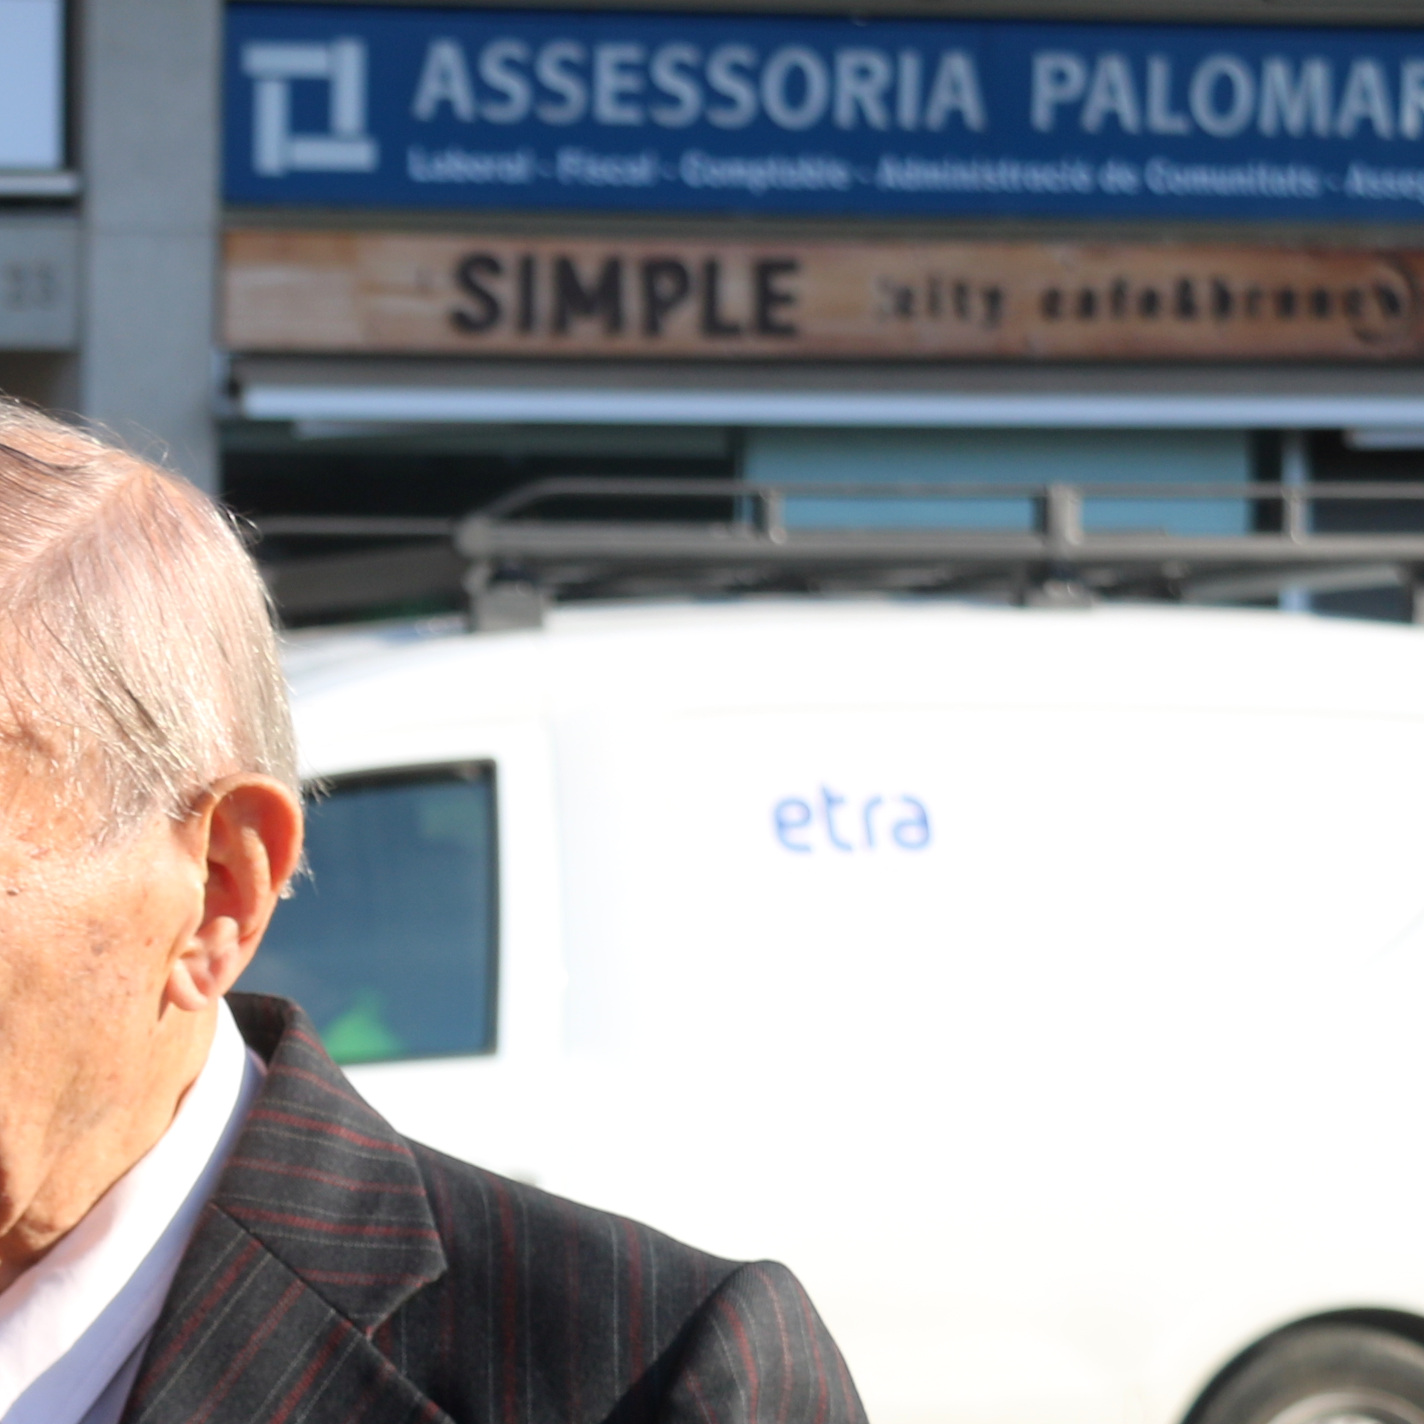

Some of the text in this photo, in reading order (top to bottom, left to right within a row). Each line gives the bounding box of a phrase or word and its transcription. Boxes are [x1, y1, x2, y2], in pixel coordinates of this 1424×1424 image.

[413, 38, 986, 132] ASSESSORIA
[407, 146, 534, 184] Laboral
[556, 148, 658, 187] Fiscal
[680, 149, 851, 196] Comptable
[1098, 159, 1139, 194] de
[1145, 157, 1320, 198] Comunitats
[450, 251, 799, 338] SIMPLE
[773, 784, 931, 852] etra
